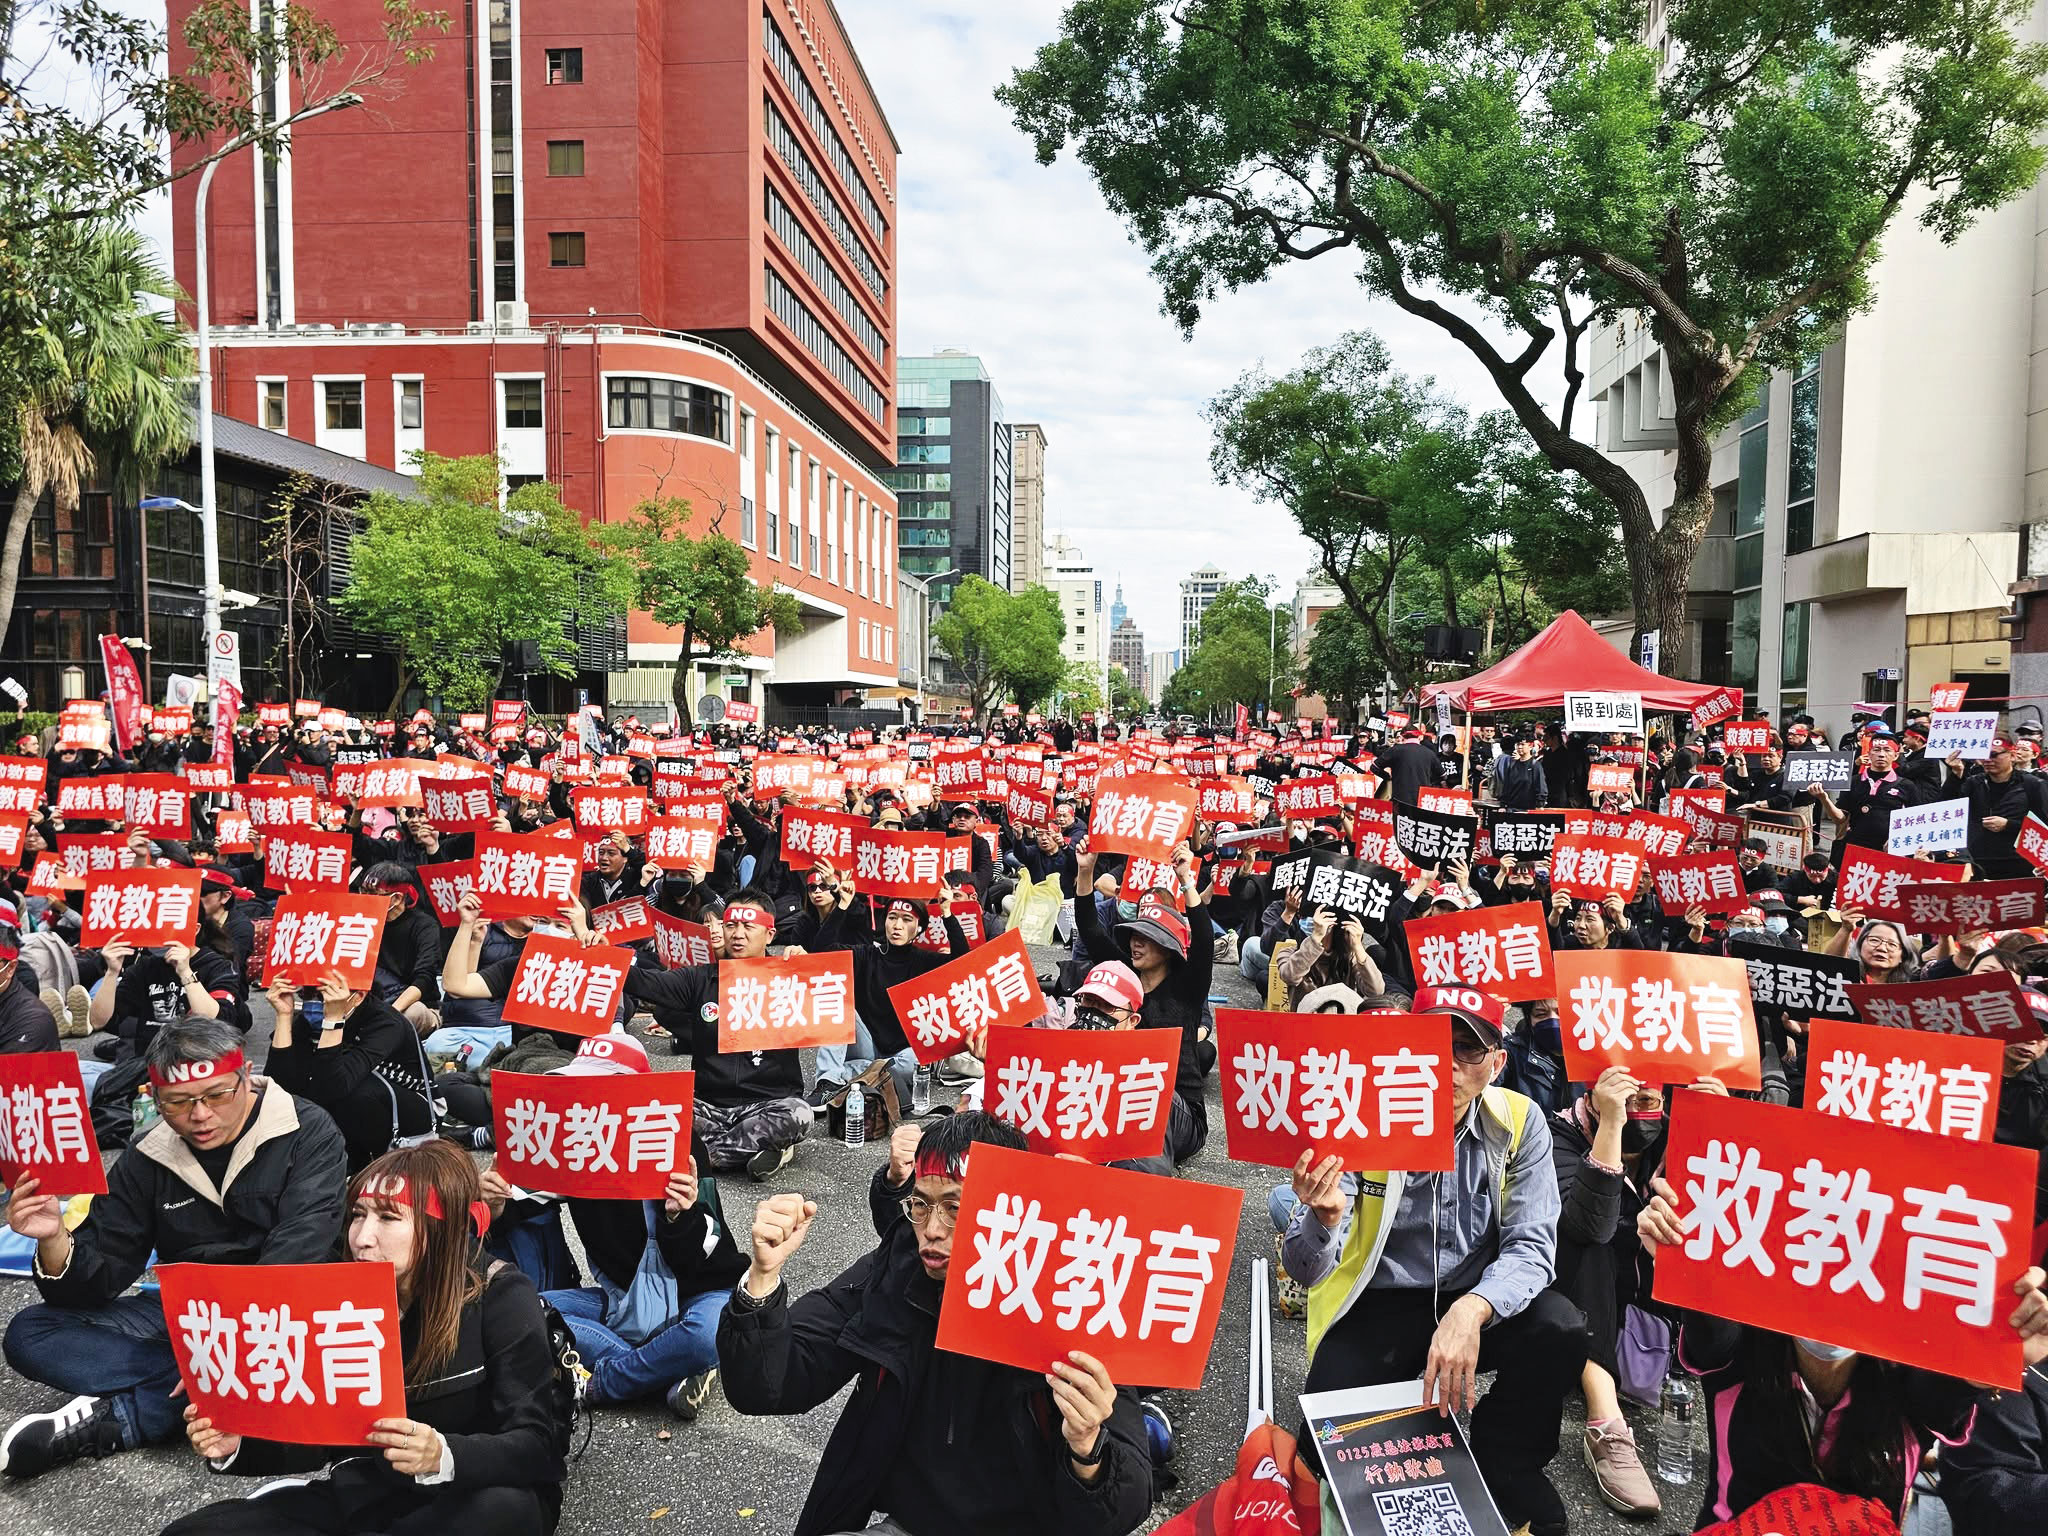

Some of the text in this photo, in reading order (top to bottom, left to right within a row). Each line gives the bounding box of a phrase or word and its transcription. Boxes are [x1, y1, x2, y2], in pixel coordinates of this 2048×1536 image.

[1575, 702, 1633, 719] 報到處
[1694, 693, 1734, 720] 救教育
[1932, 689, 1963, 708] 教育
[1726, 727, 1767, 747] 救教育
[0, 764, 43, 780] 教育
[187, 768, 228, 786] 救教育
[506, 769, 544, 796] 救教育
[756, 764, 810, 791] 救教育
[937, 760, 983, 785] 救教育
[1006, 763, 1043, 783] 救教育
[1187, 760, 1215, 775] 救教育
[1592, 770, 1631, 786] 救教育
[1788, 759, 1849, 782] 廢惡法
[1203, 788, 1253, 813] 救教育
[1290, 784, 1334, 810] 救教育
[1341, 779, 1373, 798] 救教育
[1421, 794, 1468, 813] 救教育
[249, 796, 312, 825] 救教育
[425, 788, 492, 821] 救教育
[580, 797, 643, 825] 救教育
[1009, 789, 1048, 820] 救教育
[1096, 791, 1187, 847] 救教育
[1397, 815, 1470, 860] 廢惡法
[1494, 822, 1560, 852] 廢惡法
[1565, 818, 1590, 835] 育
[1626, 819, 1684, 857] 救教育
[1684, 804, 1738, 842] 救教育
[649, 826, 714, 860] 救教育
[1744, 848, 1758, 856] NO
[268, 837, 346, 883] 救教育
[477, 847, 577, 900] 救教育
[857, 840, 939, 883] 救教育
[1554, 845, 1638, 891] 救教育
[1128, 857, 1196, 897] 救教
[1444, 887, 1460, 896] NO
[1657, 863, 1738, 904] 救教育
[88, 884, 193, 930] 救教育
[892, 900, 912, 912] NO
[1307, 865, 1392, 921] 廢惡法
[1760, 891, 1778, 900] NO
[731, 908, 756, 921] NO
[1142, 905, 1162, 918] NO
[1909, 891, 2037, 926] 救教育
[270, 910, 378, 968] 救教育
[655, 920, 710, 967] 救教育
[1418, 923, 1542, 986] 救教育
[517, 951, 622, 1018] 救教育
[908, 951, 1031, 1047] 救教育
[1435, 987, 1484, 1012] NO
[1747, 959, 1855, 1016] 廢惡法
[727, 971, 848, 1032] 救教育
[1569, 975, 1745, 1057] 救教育
[1865, 989, 2024, 1036] 救教育
[578, 1039, 613, 1058] NO
[167, 1061, 215, 1084] NO
[997, 1056, 1168, 1140] 救教育
[1232, 1042, 1440, 1140] 救教育
[1817, 1049, 1991, 1140] 救教育
[505, 1098, 682, 1174] 救教育
[359, 1173, 407, 1197] NO
[1681, 1138, 2013, 1327] 救教育
[964, 1193, 1220, 1343] 救教育
[179, 1299, 385, 1407] 救教育
[1336, 1432, 1454, 1462] 0125廢惡法救教育
[1364, 1455, 1446, 1485] 行動歌曲
